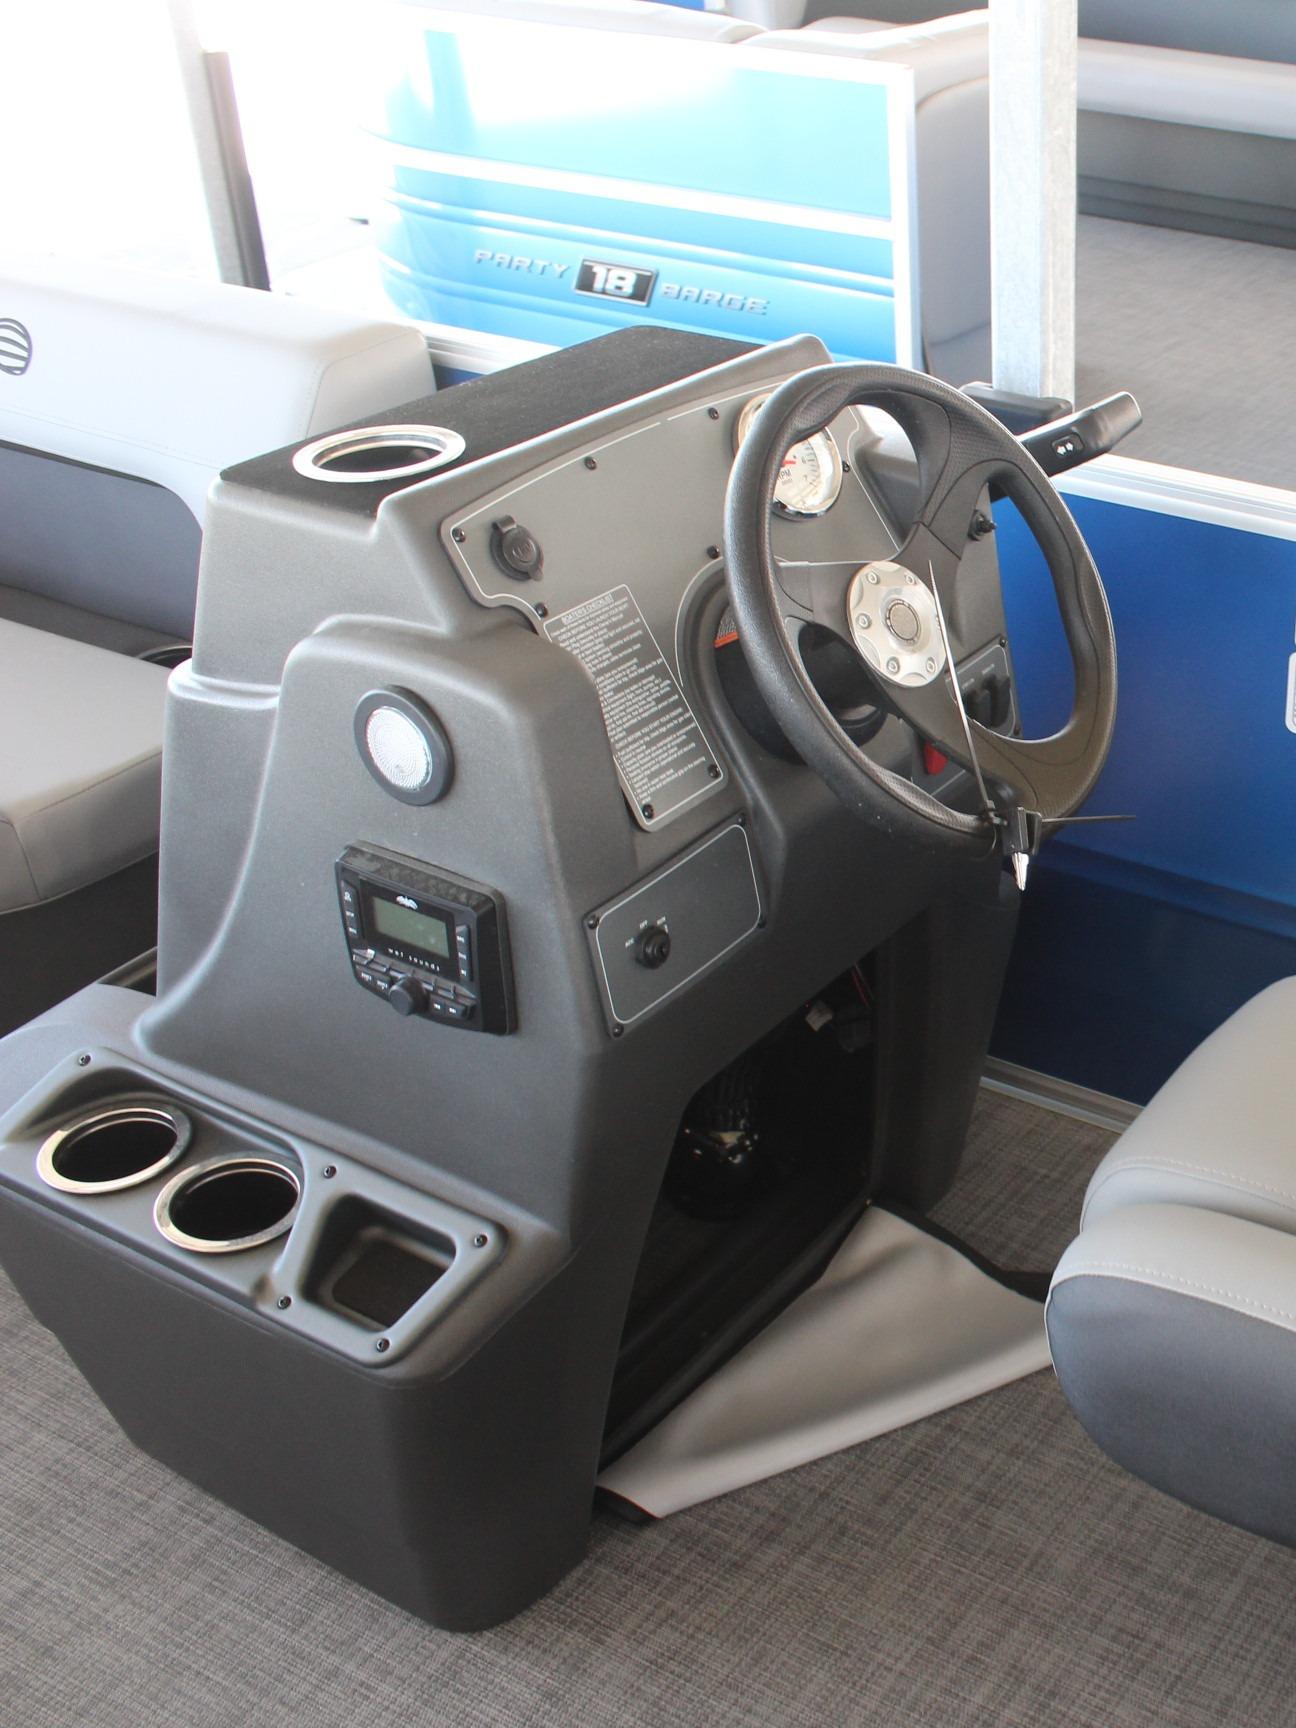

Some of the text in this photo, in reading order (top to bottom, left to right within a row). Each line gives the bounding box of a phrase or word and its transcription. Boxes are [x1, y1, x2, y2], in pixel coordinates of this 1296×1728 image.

[474, 249, 770, 315] PARTY 18 BARGE
